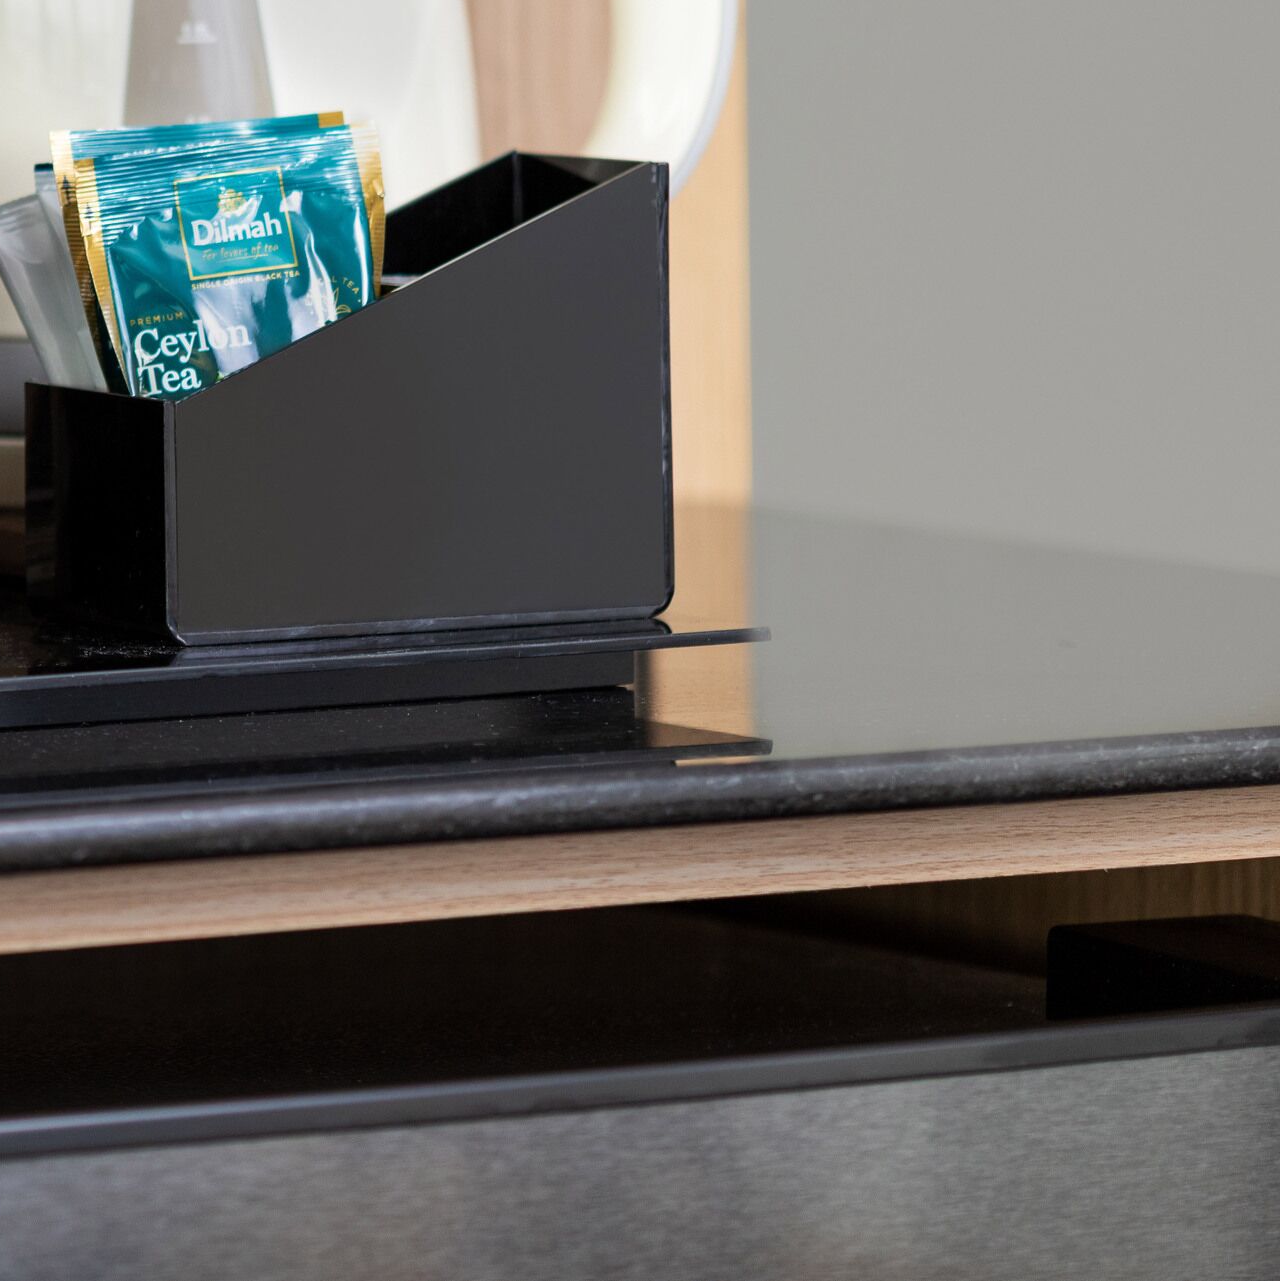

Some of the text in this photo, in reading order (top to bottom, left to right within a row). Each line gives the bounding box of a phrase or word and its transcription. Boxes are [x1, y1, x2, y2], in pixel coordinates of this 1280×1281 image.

[191, 211, 283, 246] Dilmah
[202, 241, 279, 261] For lovers of tea
[191, 269, 300, 290] SINGLE ORIGIN BLACK TEA
[129, 311, 185, 326] PREMIUM
[134, 318, 252, 364] Ceylon
[136, 362, 202, 397] Tea
